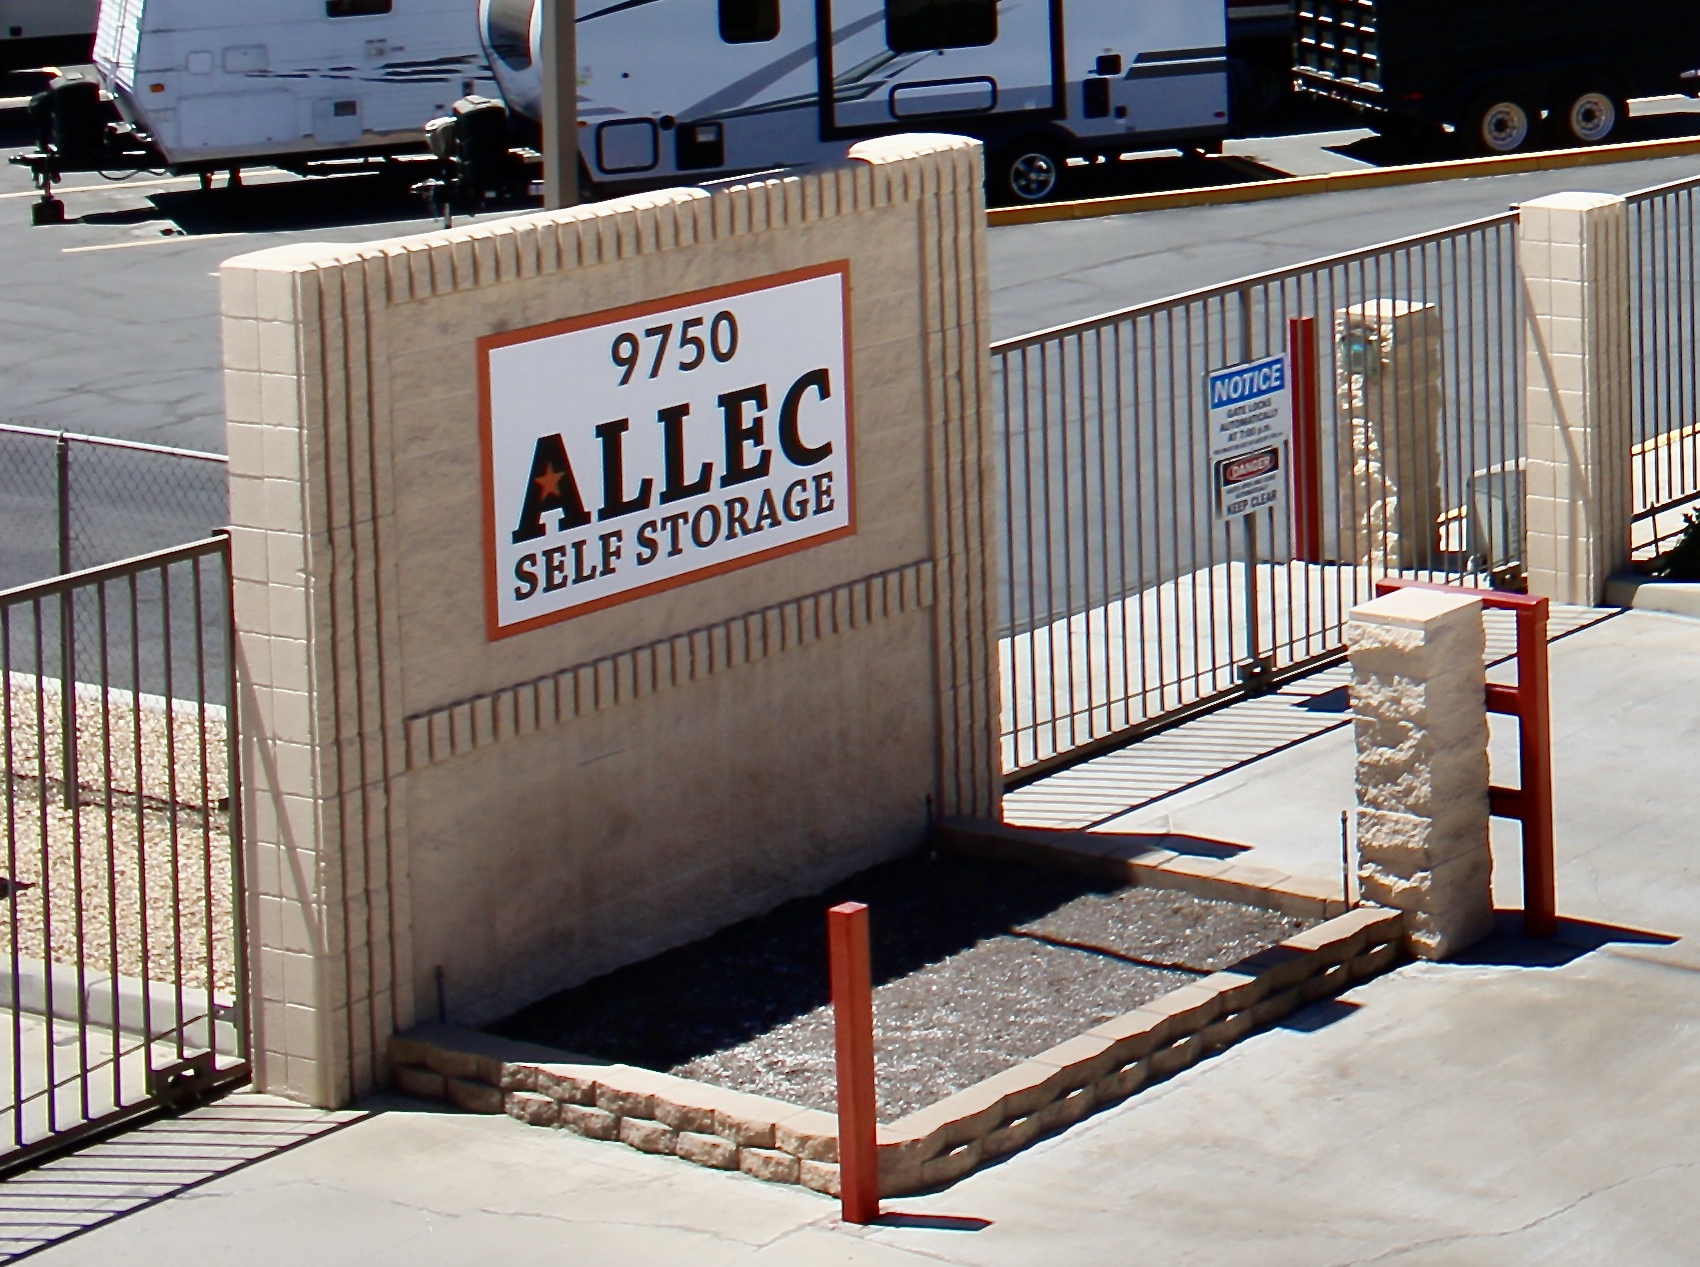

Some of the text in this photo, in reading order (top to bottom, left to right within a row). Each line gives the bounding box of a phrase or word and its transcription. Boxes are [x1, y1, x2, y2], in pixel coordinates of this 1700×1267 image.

[611, 310, 738, 386] 9750
[1213, 363, 1281, 403] NOTICE
[511, 368, 833, 544] ALLEC
[1232, 456, 1271, 478] DANGER
[1227, 499, 1249, 515] KEEP
[1250, 489, 1277, 508] CLEAR
[513, 471, 836, 601] SELF STORAGE
